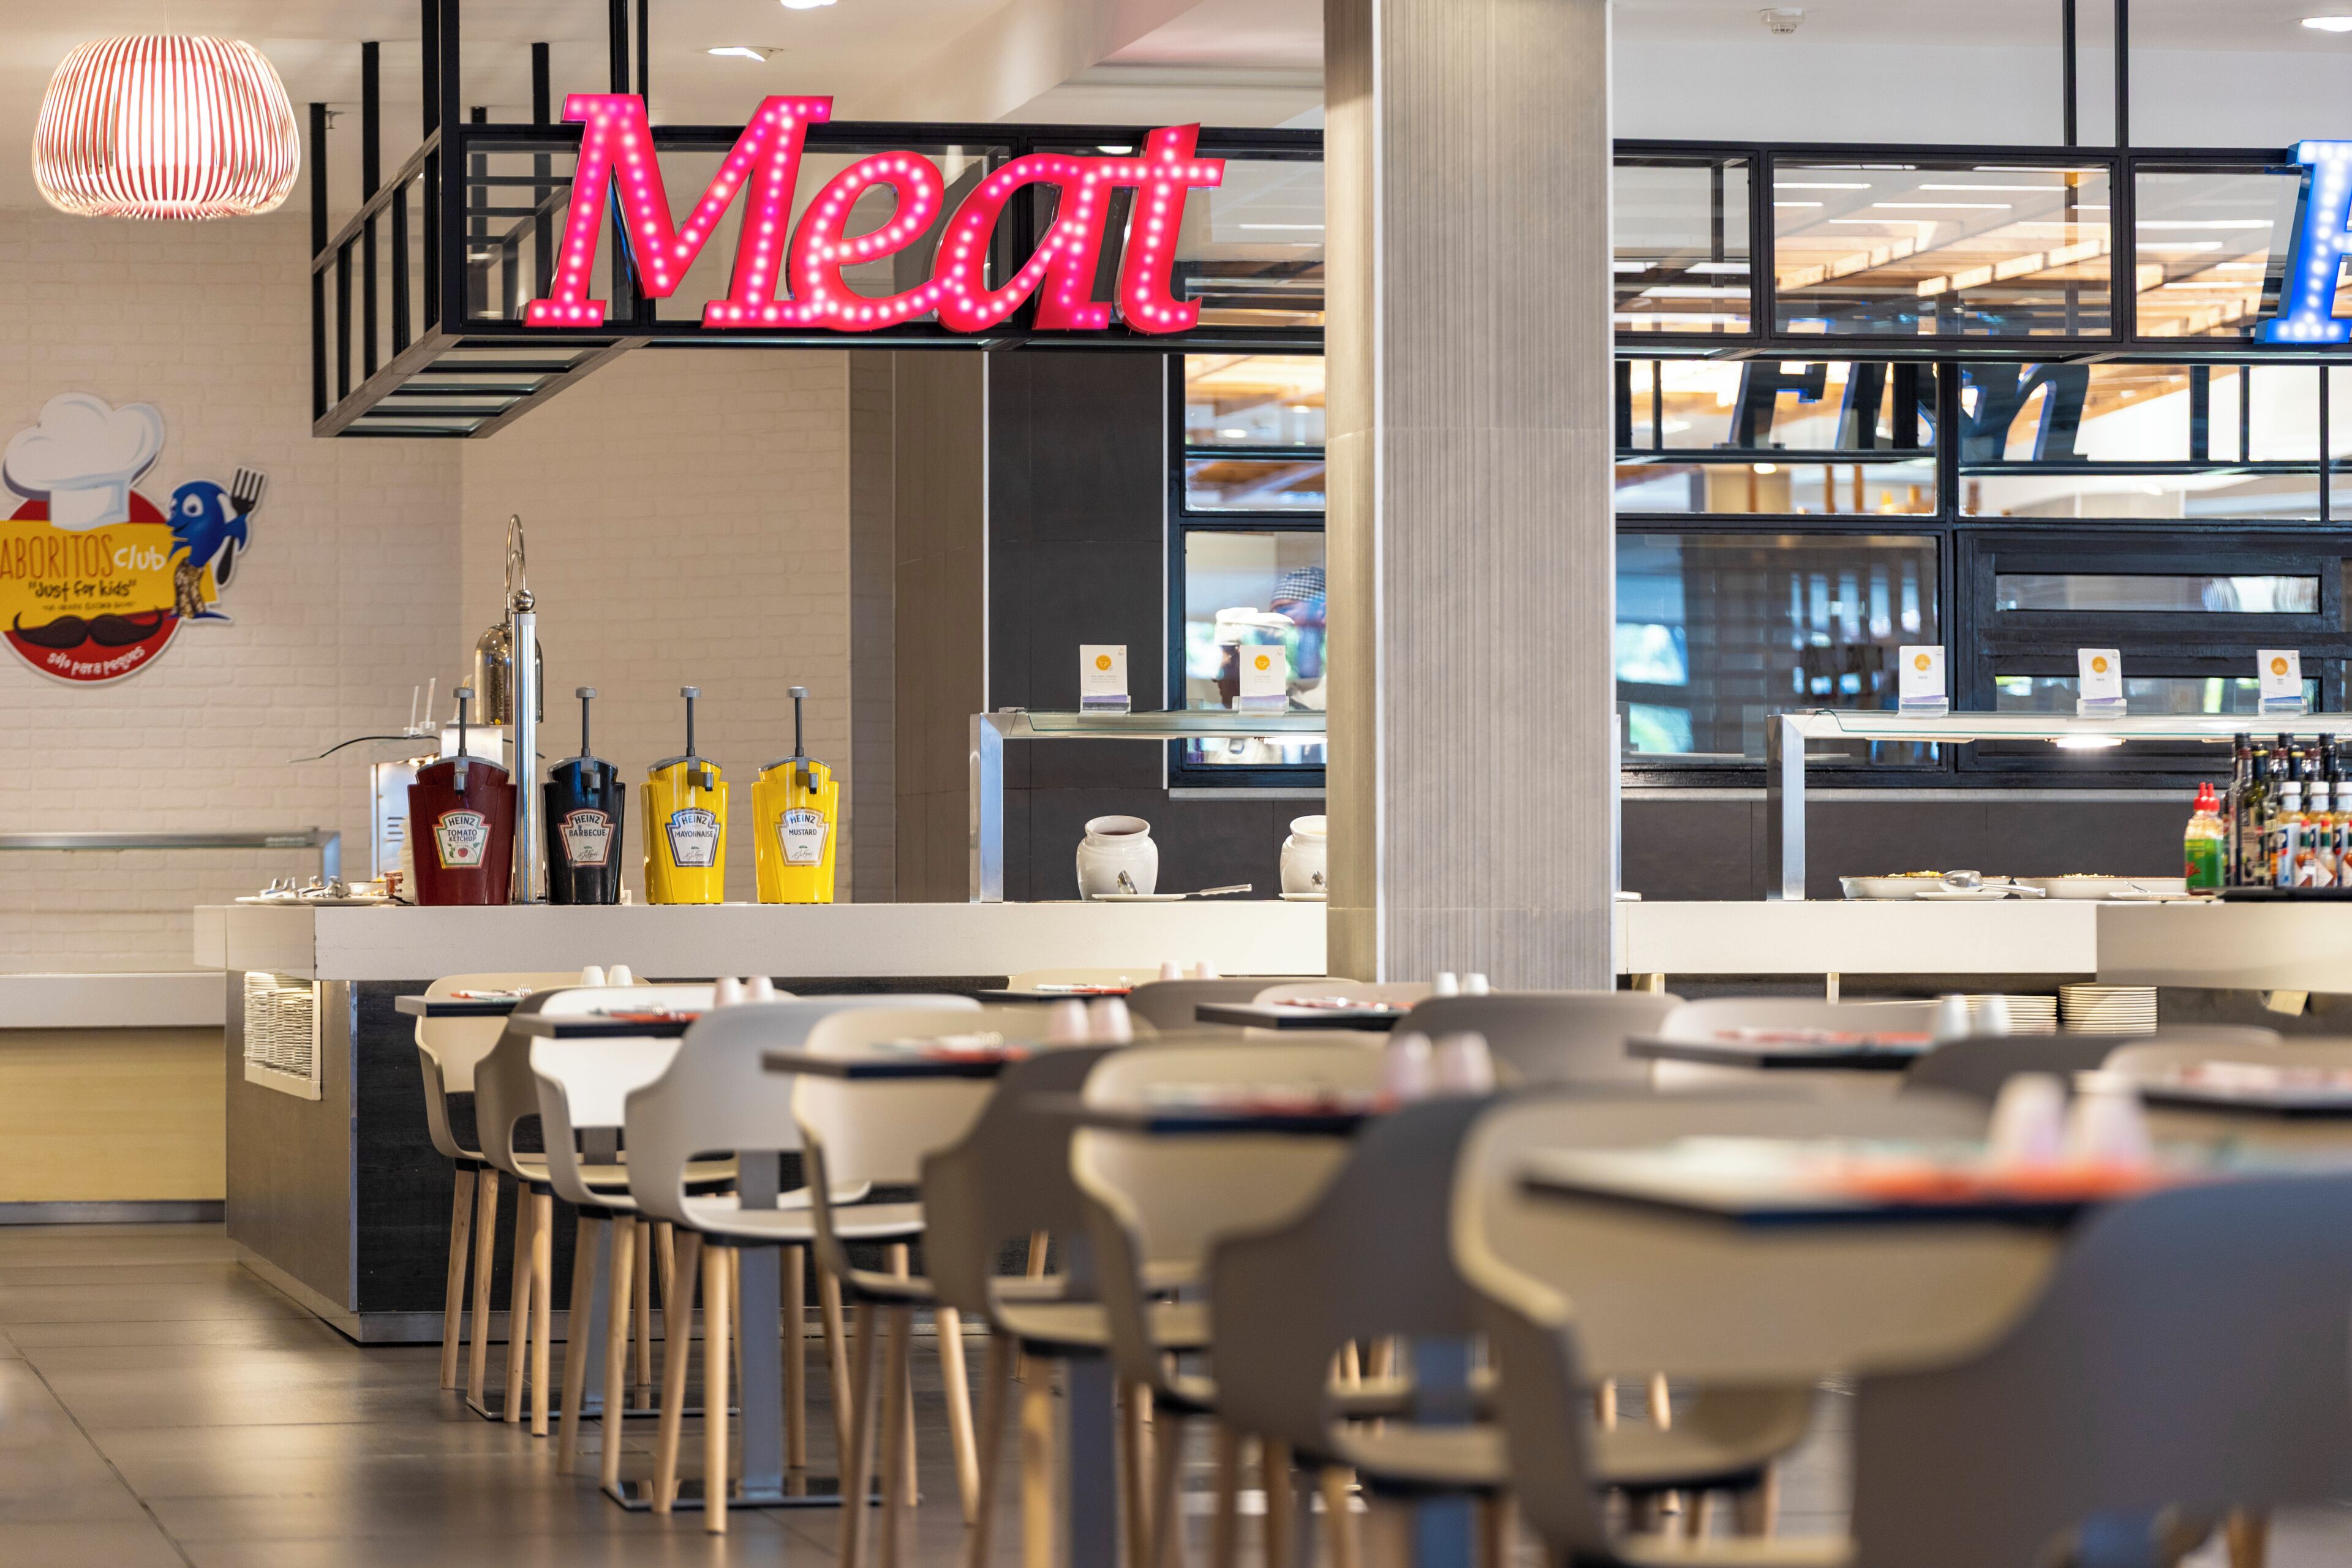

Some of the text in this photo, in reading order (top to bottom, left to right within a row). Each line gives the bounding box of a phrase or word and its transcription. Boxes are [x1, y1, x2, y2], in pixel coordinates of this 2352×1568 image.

[522, 92, 1226, 335] Meat
[113, 544, 166, 571] Club
[74, 580, 96, 597] for
[70, 661, 103, 677] para
[102, 646, 146, 677] peques
[448, 816, 476, 826] HEINZ
[574, 814, 601, 824] HEINZ
[681, 815, 707, 825] HEINZ
[790, 814, 816, 824] HEINZ
